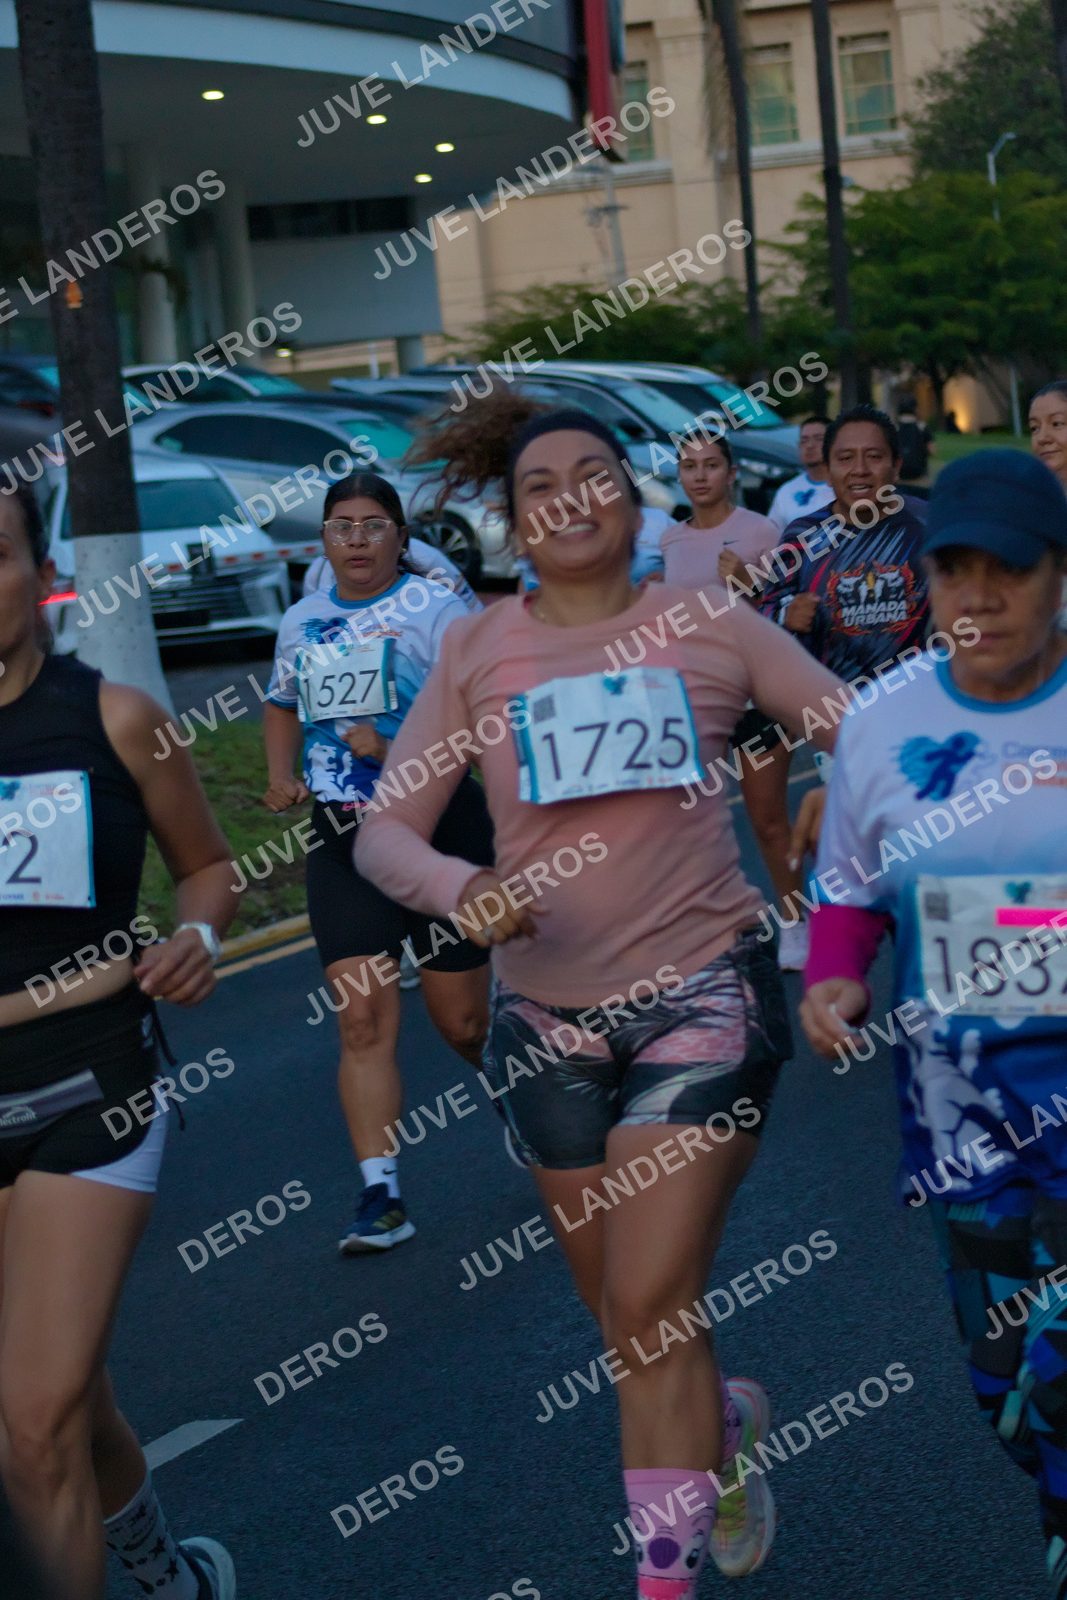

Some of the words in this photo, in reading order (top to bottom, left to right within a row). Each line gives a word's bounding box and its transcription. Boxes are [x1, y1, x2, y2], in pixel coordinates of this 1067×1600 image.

[841, 600, 908, 618] MANADA
[843, 611, 908, 628] URBANA
[303, 669, 381, 711] 1527
[542, 717, 689, 781] 1725
[934, 936, 1067, 997] 183
